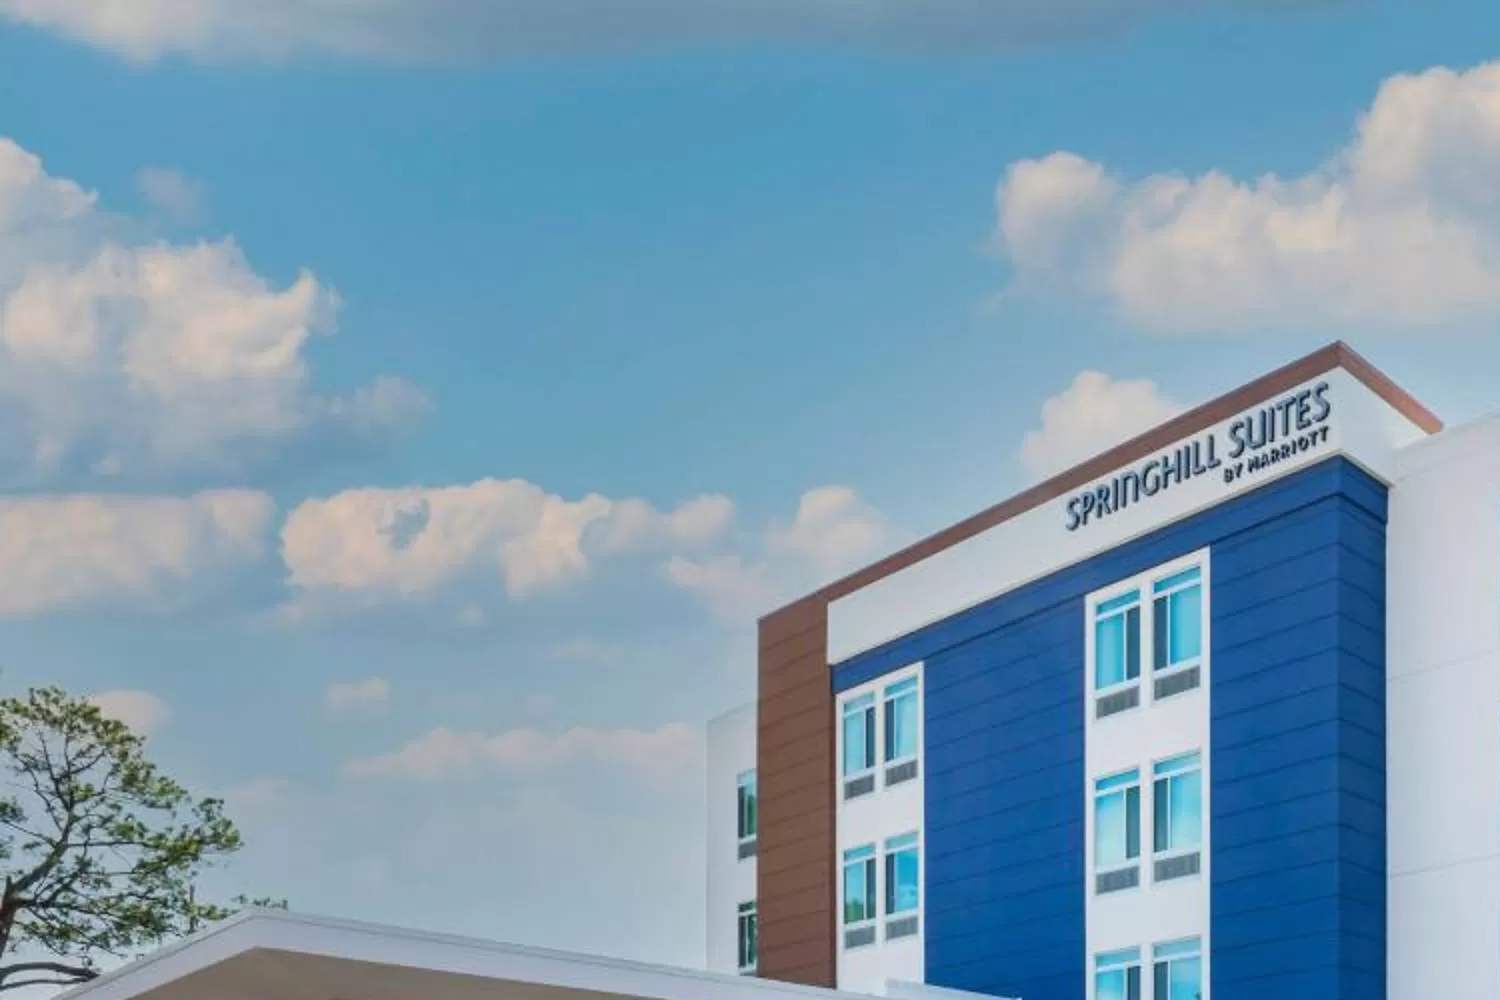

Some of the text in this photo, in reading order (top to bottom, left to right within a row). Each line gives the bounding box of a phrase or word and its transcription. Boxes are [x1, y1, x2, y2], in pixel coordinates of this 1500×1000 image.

[1066, 381, 1331, 531] SPRINGHILL SUITES
[1223, 426, 1329, 483] BY MARRIOTT
